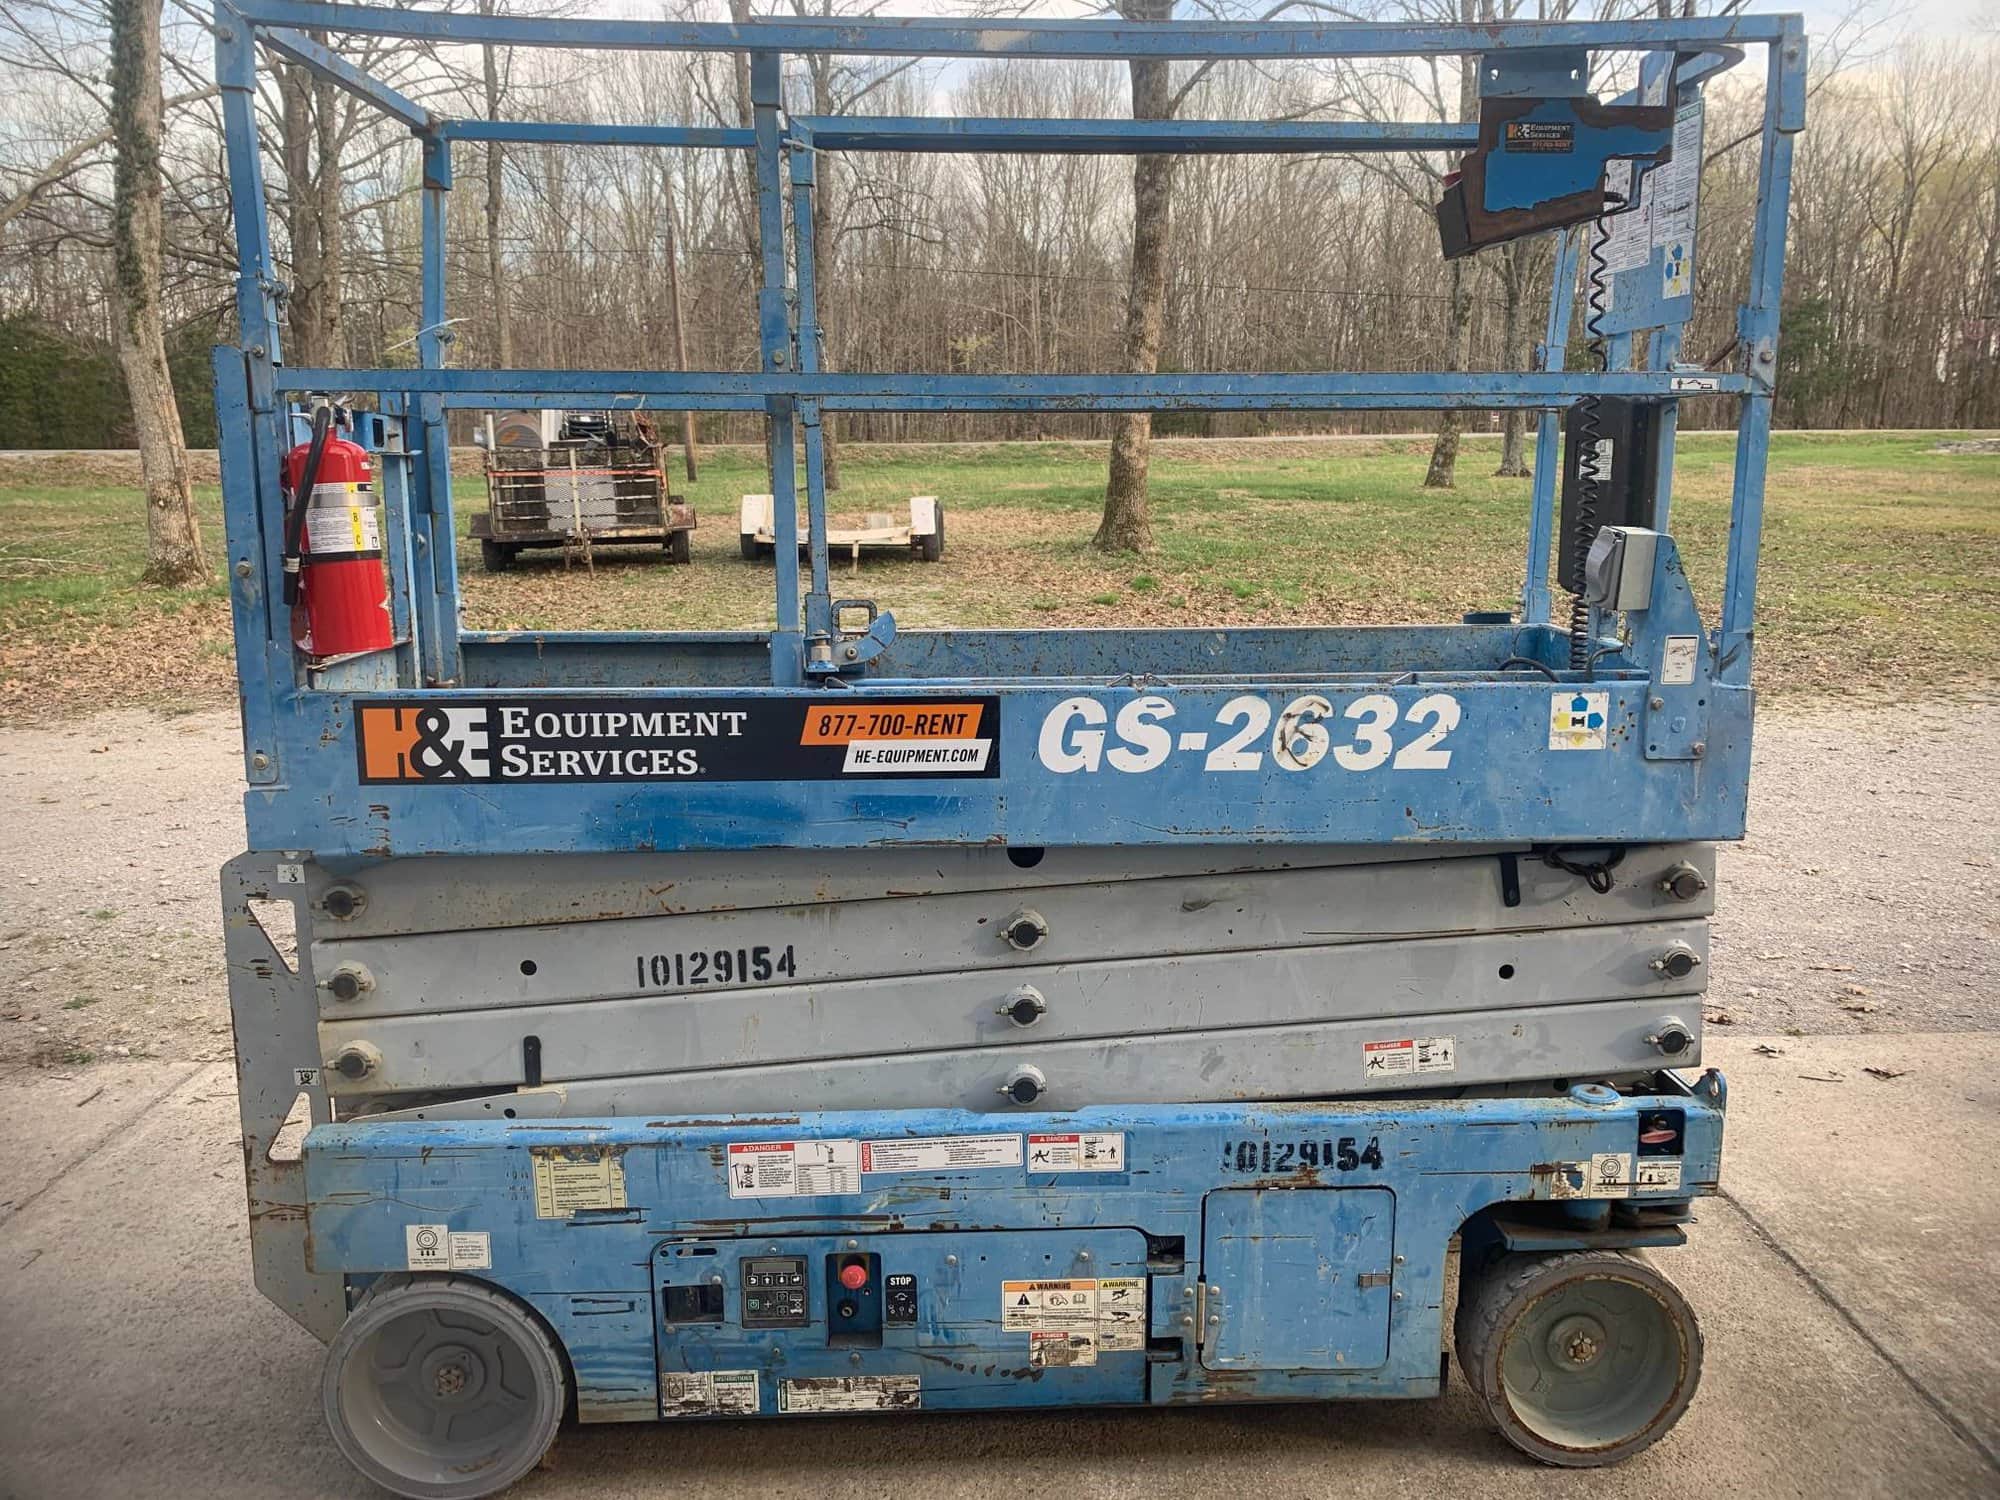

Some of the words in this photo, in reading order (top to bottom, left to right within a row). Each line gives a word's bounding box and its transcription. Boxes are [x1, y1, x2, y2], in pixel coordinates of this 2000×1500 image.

[818, 713, 969, 737] 877-700-RENT
[1037, 694, 1462, 774] GS-2632
[362, 707, 490, 778] H&E
[498, 707, 748, 738] EQUIPMENT
[854, 748, 979, 764] HE-EQUIPMENT.COM
[637, 944, 797, 988] 10129154
[748, 1143, 782, 1152] DANGER
[1223, 1136, 1384, 1173] 10129154
[890, 1276, 912, 1286] STOP
[1036, 1282, 1072, 1291] WARNING
[1108, 1280, 1139, 1288] WARNING
